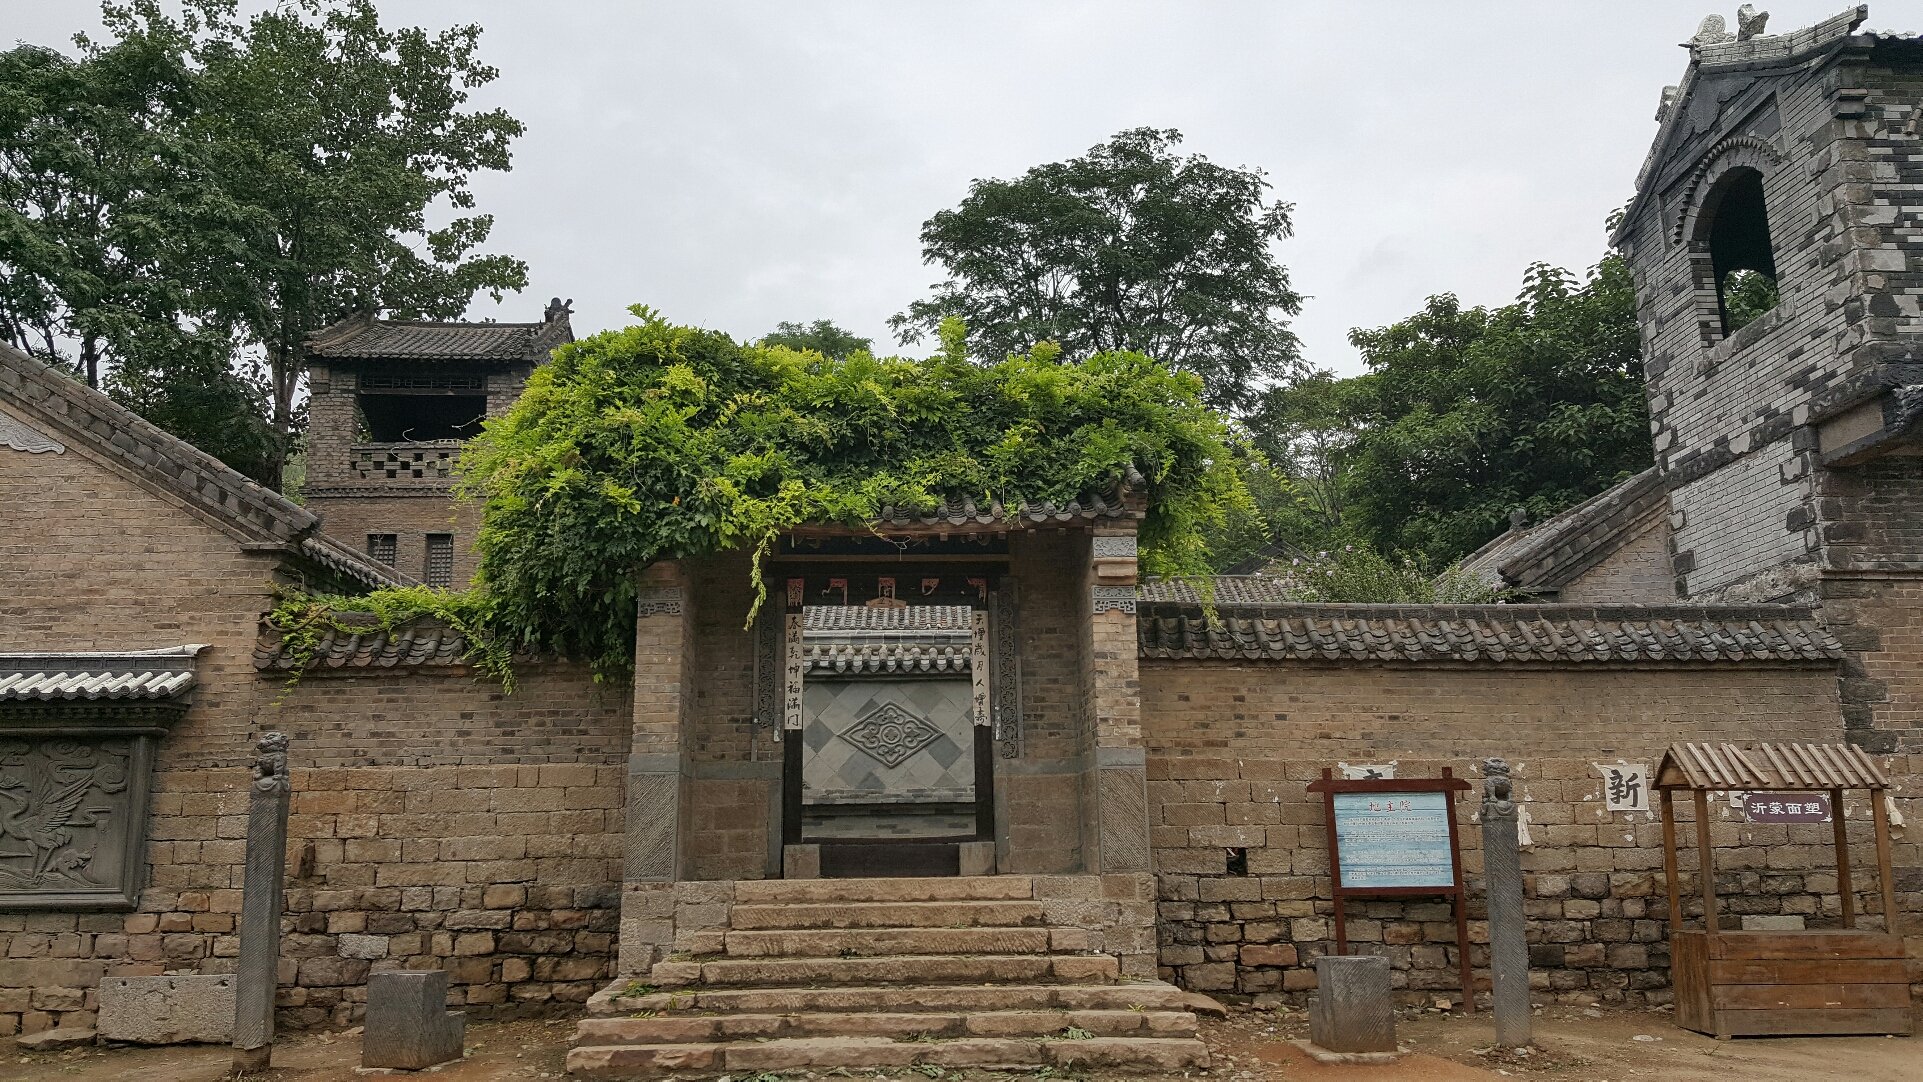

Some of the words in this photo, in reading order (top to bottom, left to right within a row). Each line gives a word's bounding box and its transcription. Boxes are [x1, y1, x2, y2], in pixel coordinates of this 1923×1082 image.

[1608, 769, 1641, 807] 新
[1368, 800, 1412, 812] 地主院
[1750, 802, 1823, 814] 沂蒙面塑
